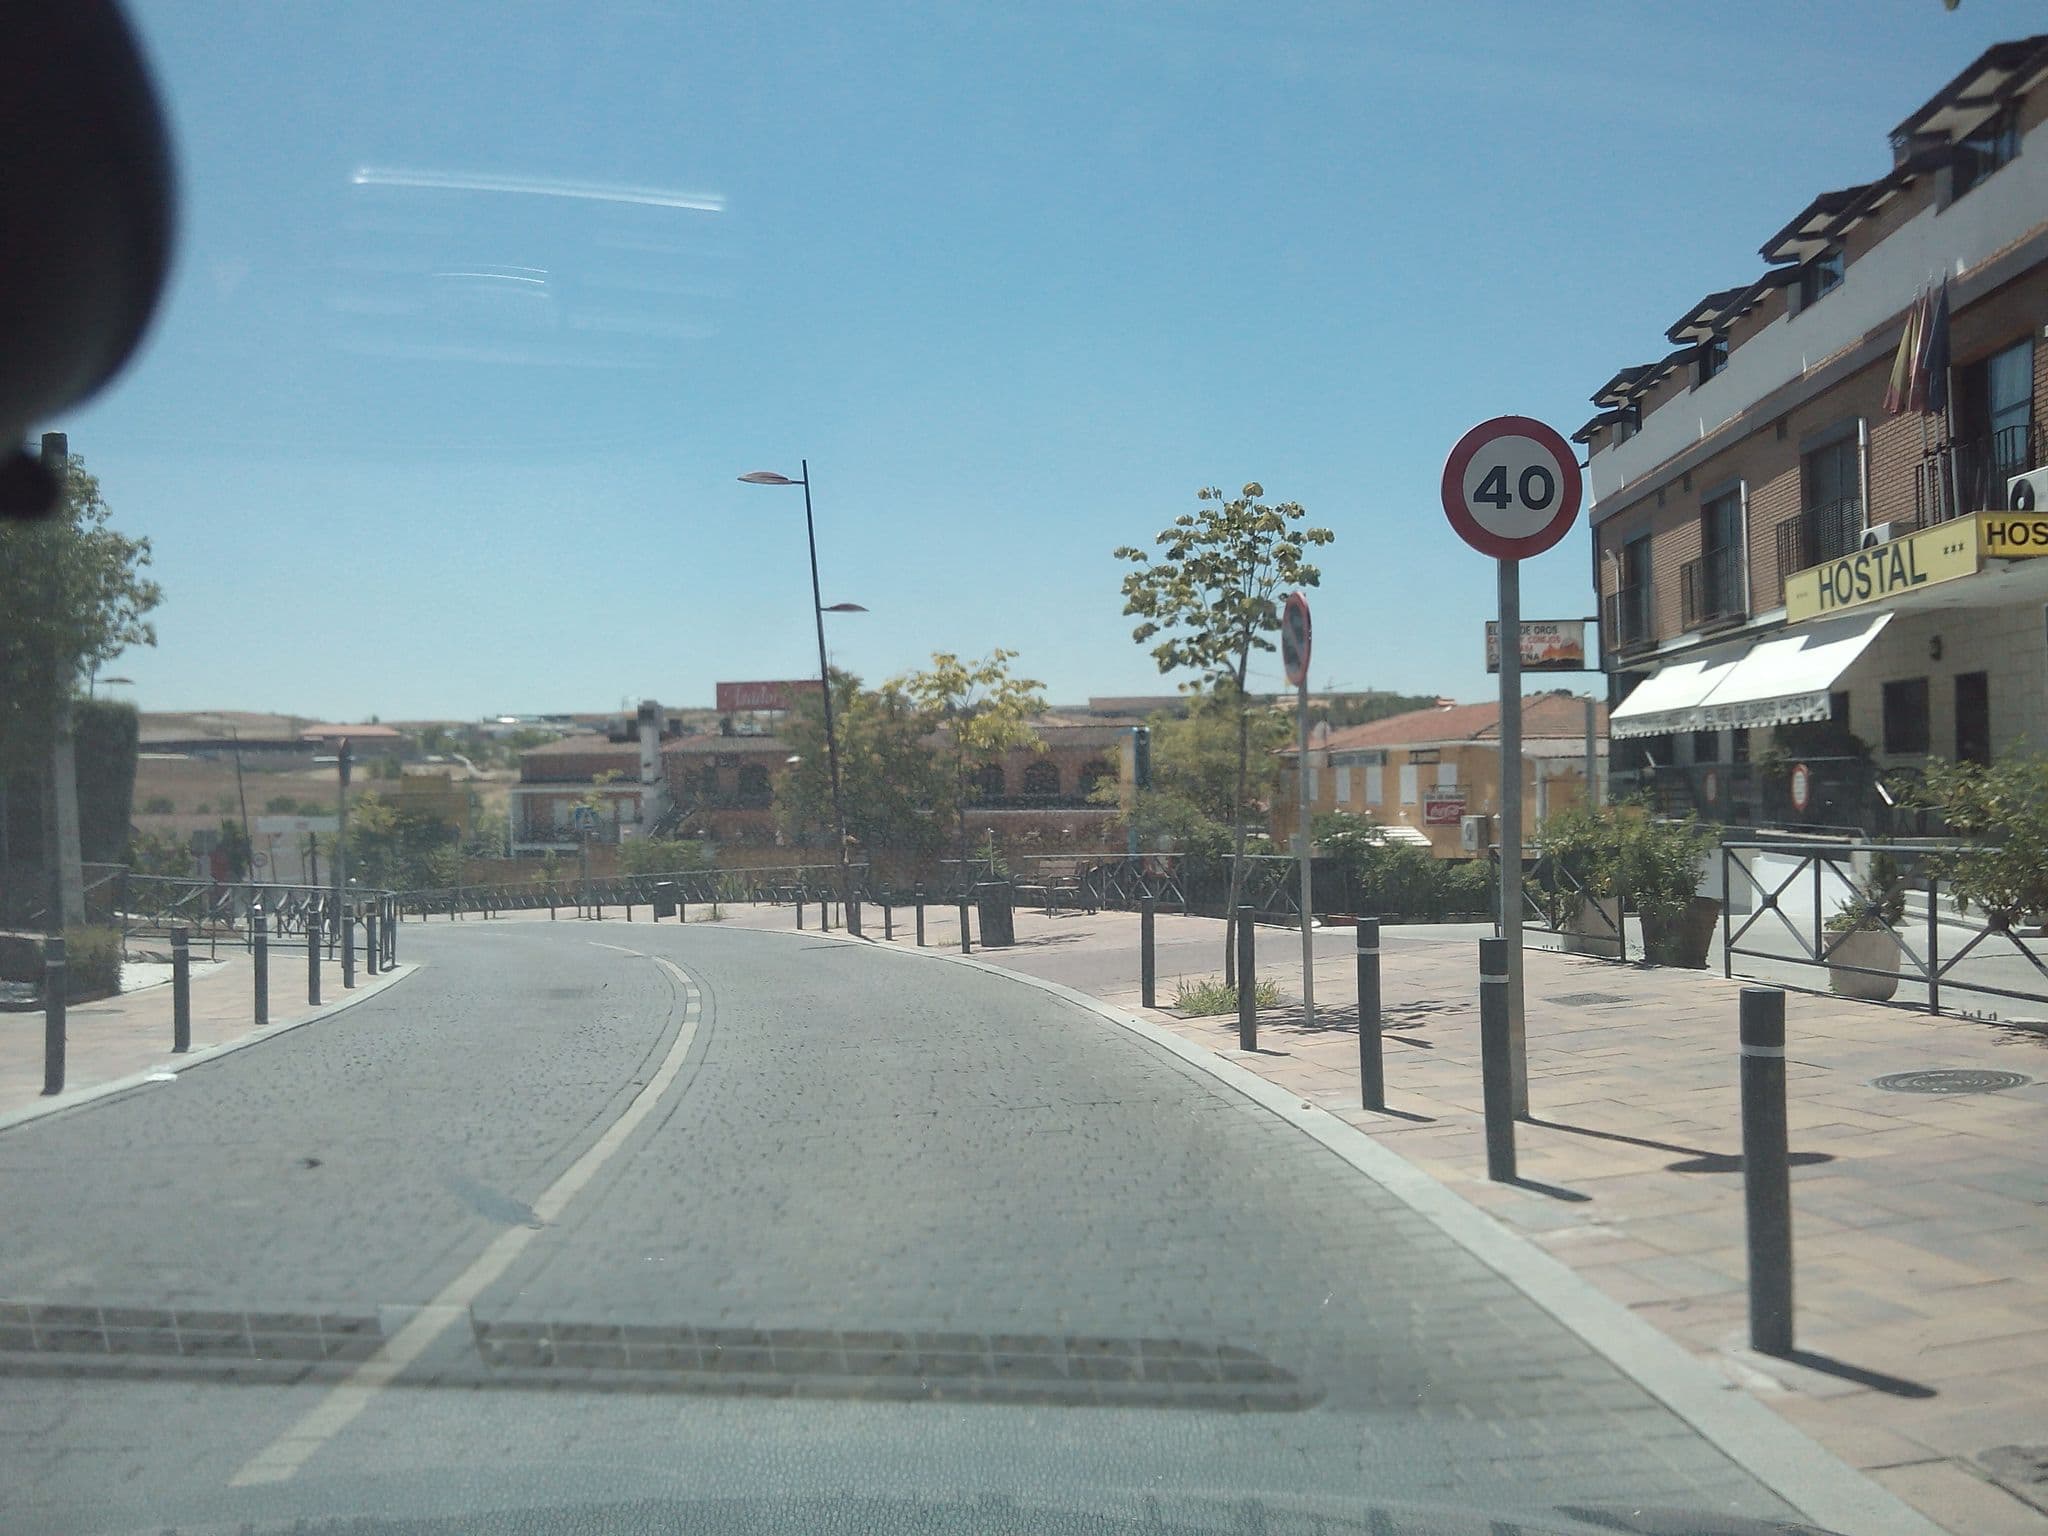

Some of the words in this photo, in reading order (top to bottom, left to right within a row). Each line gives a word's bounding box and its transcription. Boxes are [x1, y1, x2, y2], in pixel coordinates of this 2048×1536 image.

[1473, 465, 1556, 510] 40
[1818, 539, 1927, 609] HOSTAL
[1533, 625, 1558, 635] OROS
